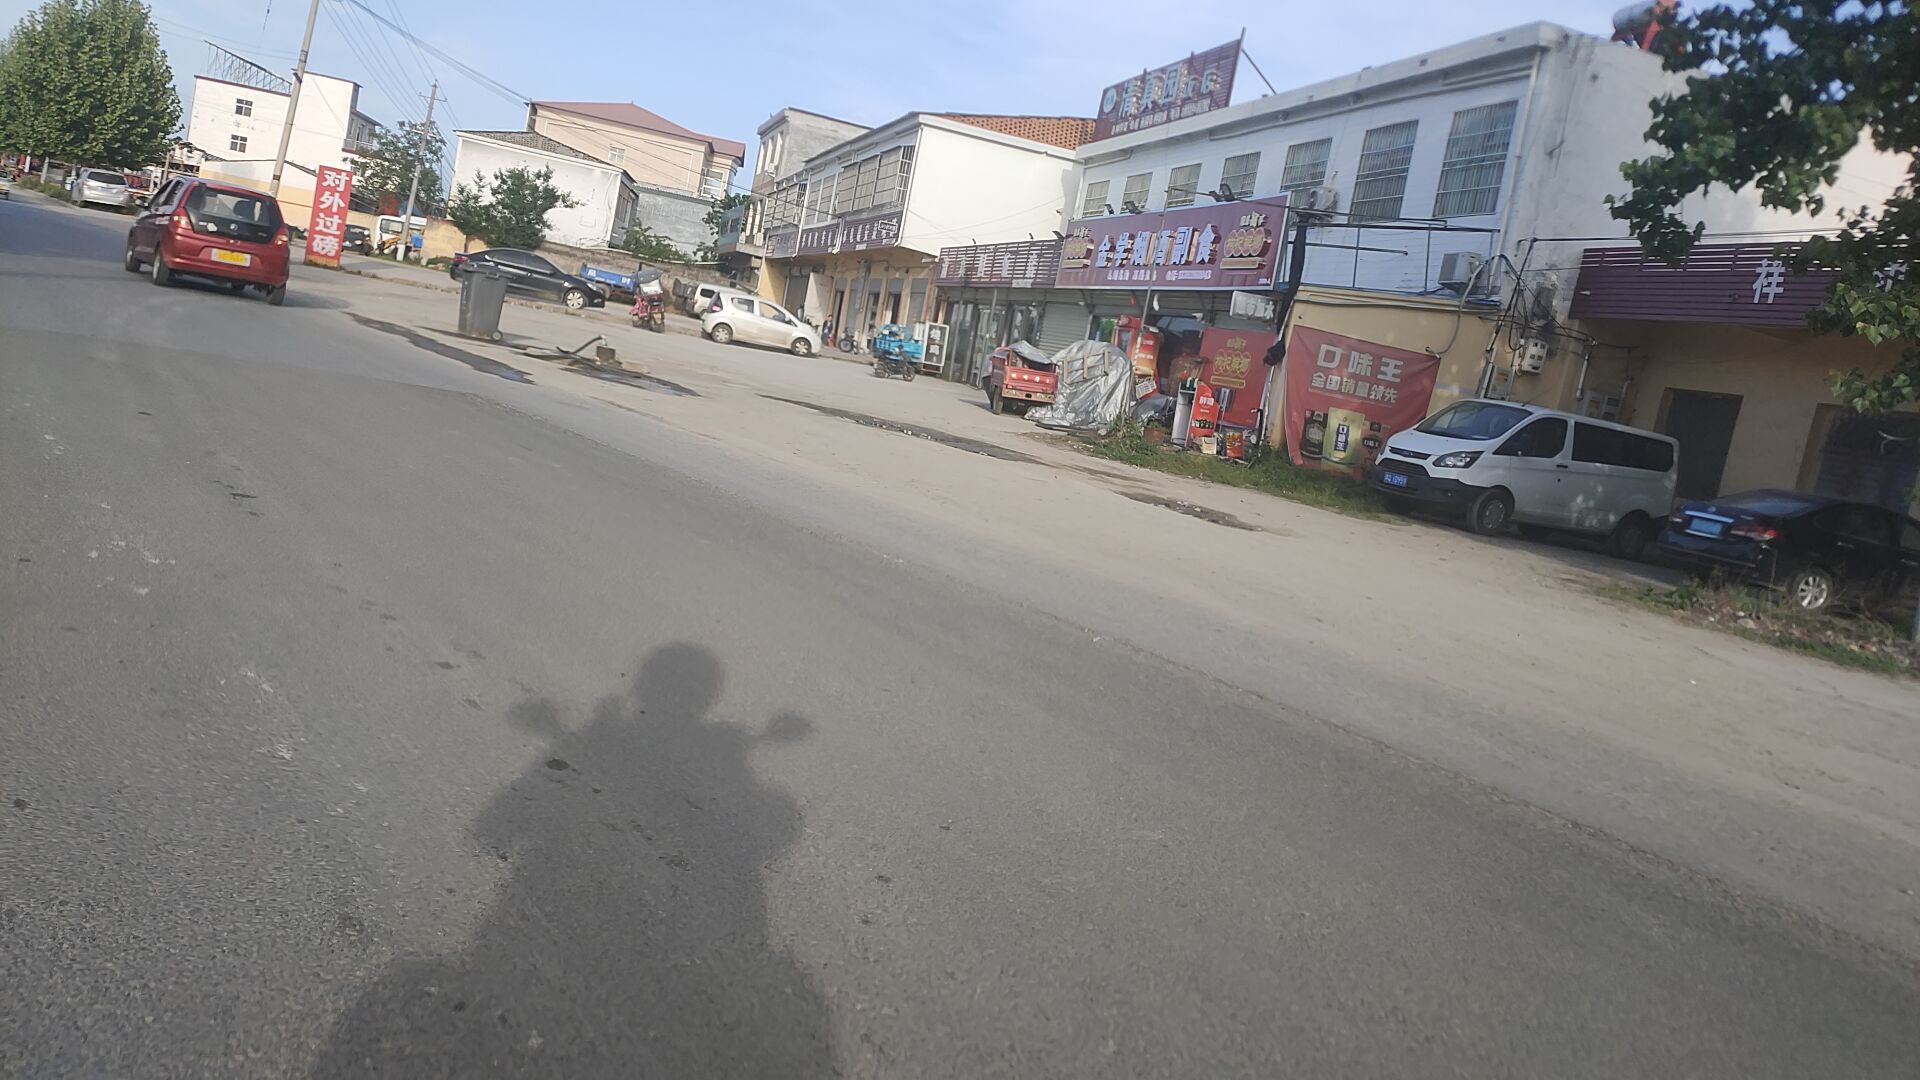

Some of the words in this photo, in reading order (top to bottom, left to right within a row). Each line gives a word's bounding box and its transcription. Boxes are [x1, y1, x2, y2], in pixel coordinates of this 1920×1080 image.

[312, 170, 349, 257] 对外过磅
[1316, 343, 1405, 384] 口味王
[1310, 371, 1399, 404] 全国销量领先
